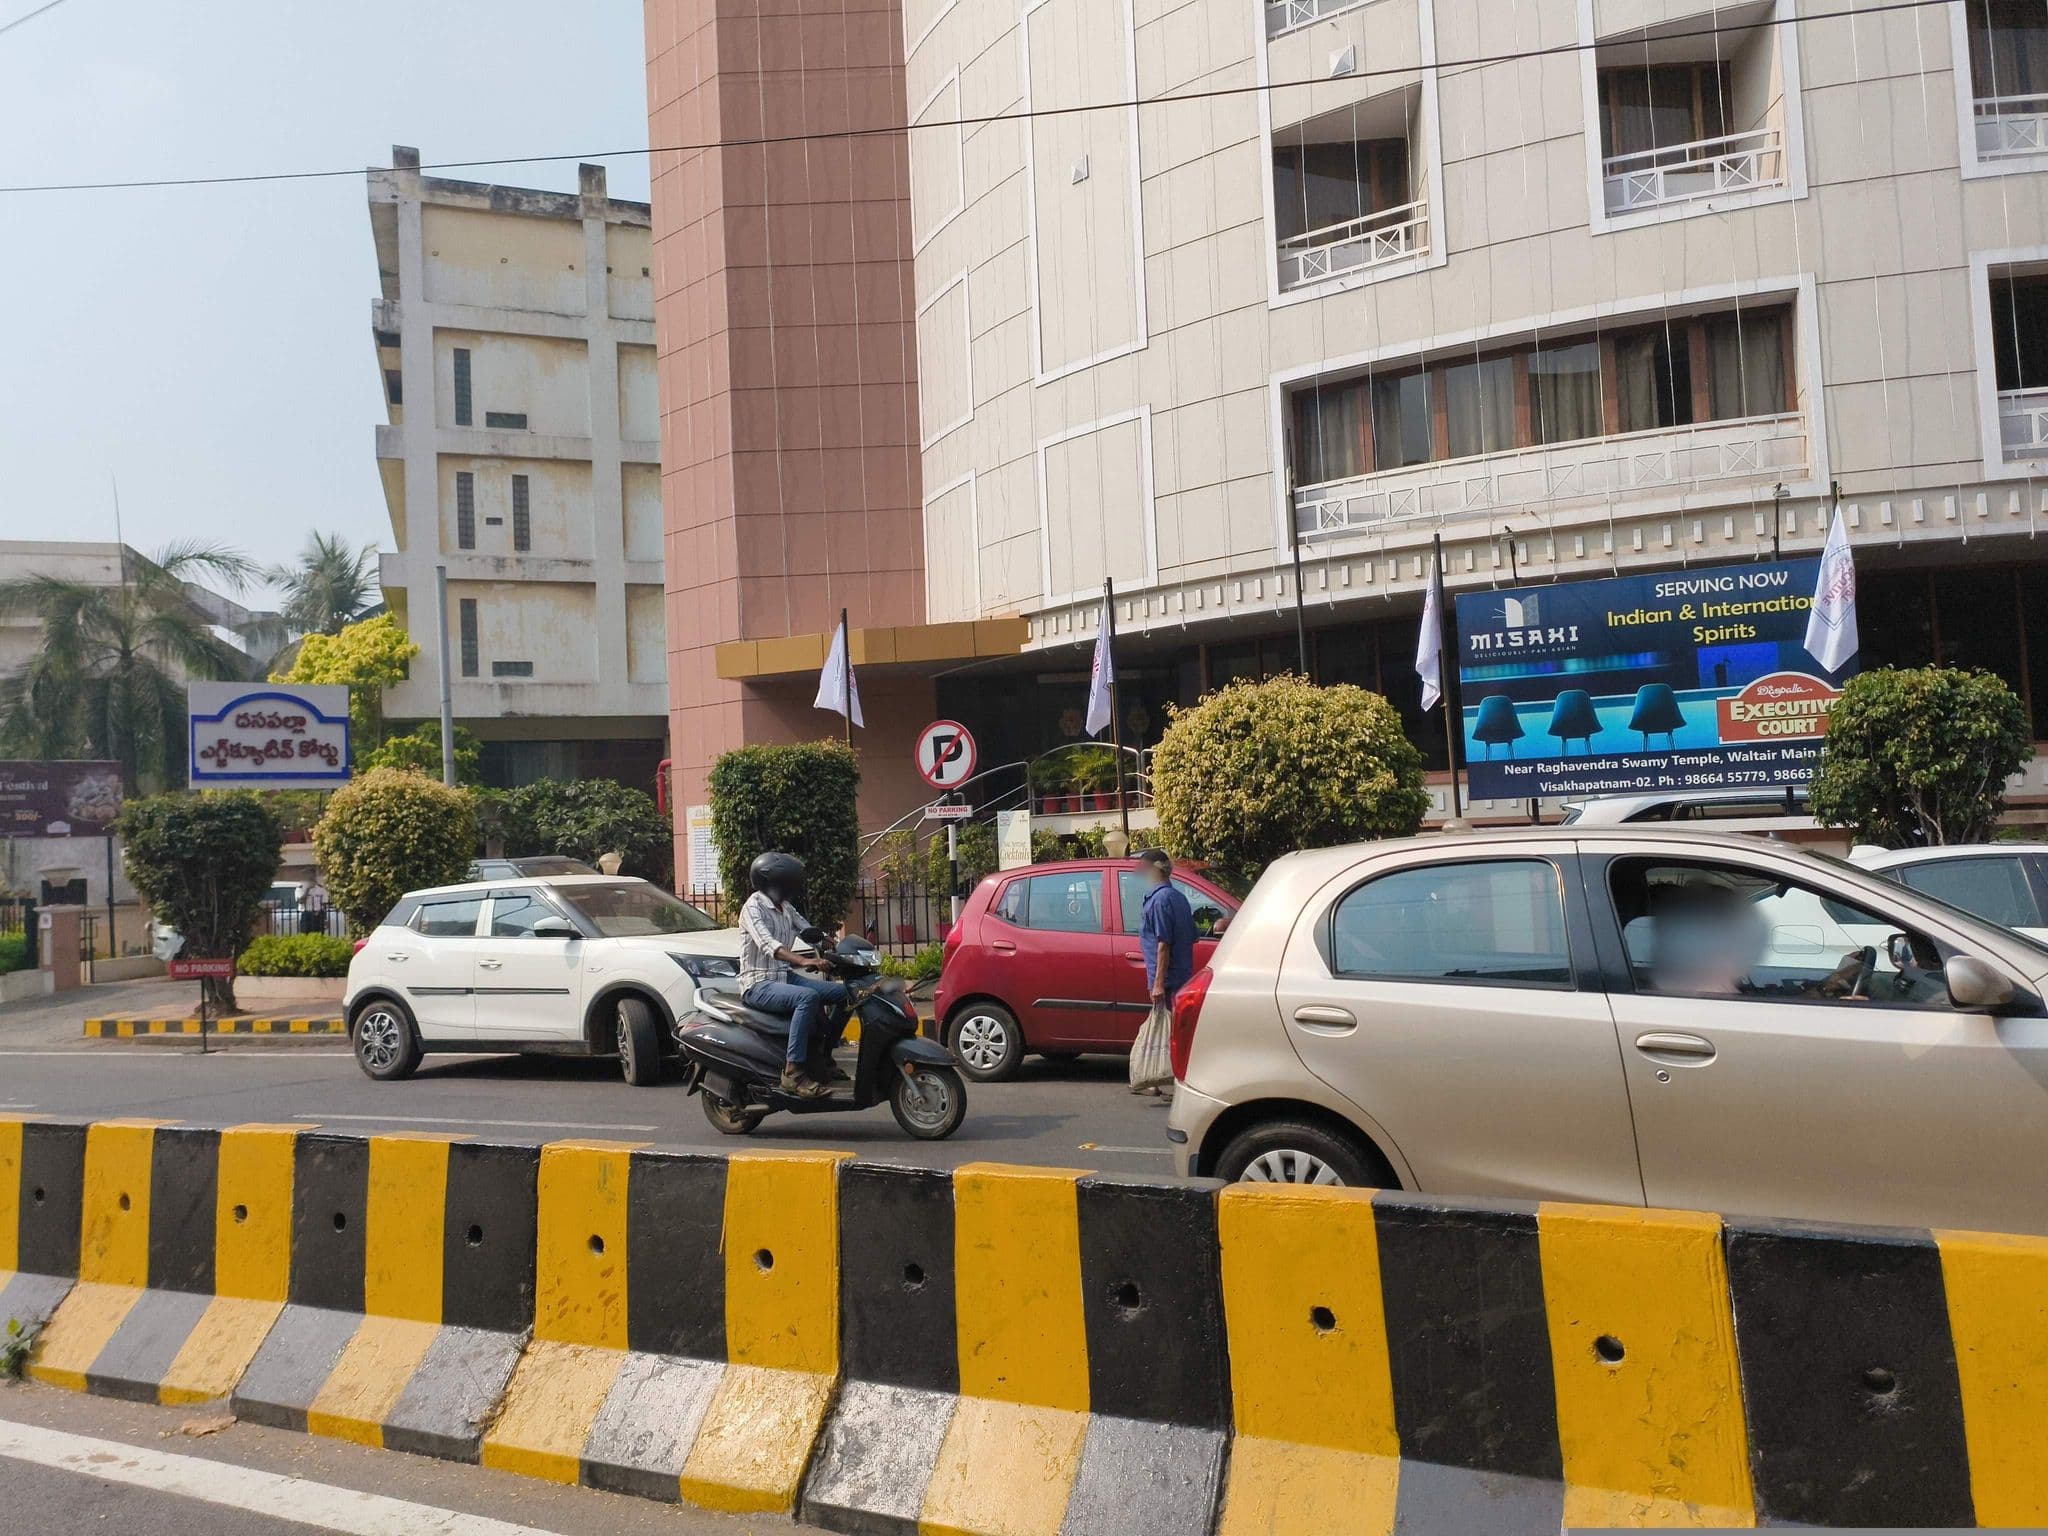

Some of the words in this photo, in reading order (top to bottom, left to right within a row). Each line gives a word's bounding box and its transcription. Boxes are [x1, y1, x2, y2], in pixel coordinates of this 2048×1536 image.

[1655, 577, 1734, 598] SERVING
[1739, 571, 1788, 590] NOW
[1607, 609, 1672, 627] Indian
[1679, 604, 1696, 620] &
[1470, 626, 1579, 650] MISAKI
[1693, 624, 1756, 644] Spirits
[1474, 649, 1527, 659] DELICIOUSLY
[1551, 645, 1577, 653] ASIAN
[235, 711, 307, 735] దసపల్లా
[1757, 718, 1817, 735] COURT
[299, 738, 339, 767] కోర్టు
[933, 734, 963, 779] P
[1504, 764, 1533, 775] Near
[1537, 759, 1618, 775] Raghavendra
[1622, 757, 1668, 769] Swamy
[1671, 753, 1723, 767] Temple,
[1727, 750, 1777, 762] Waltair
[1781, 747, 1816, 760] Main
[1540, 776, 1655, 792] Visakhapatnam-02.
[1658, 775, 1674, 786] Ph
[1685, 773, 1723, 785] 98664
[1727, 770, 1770, 782] 55779,
[1774, 768, 1813, 780] 98663
[175, 963, 189, 973] NO
[191, 963, 230, 973] PARKING
